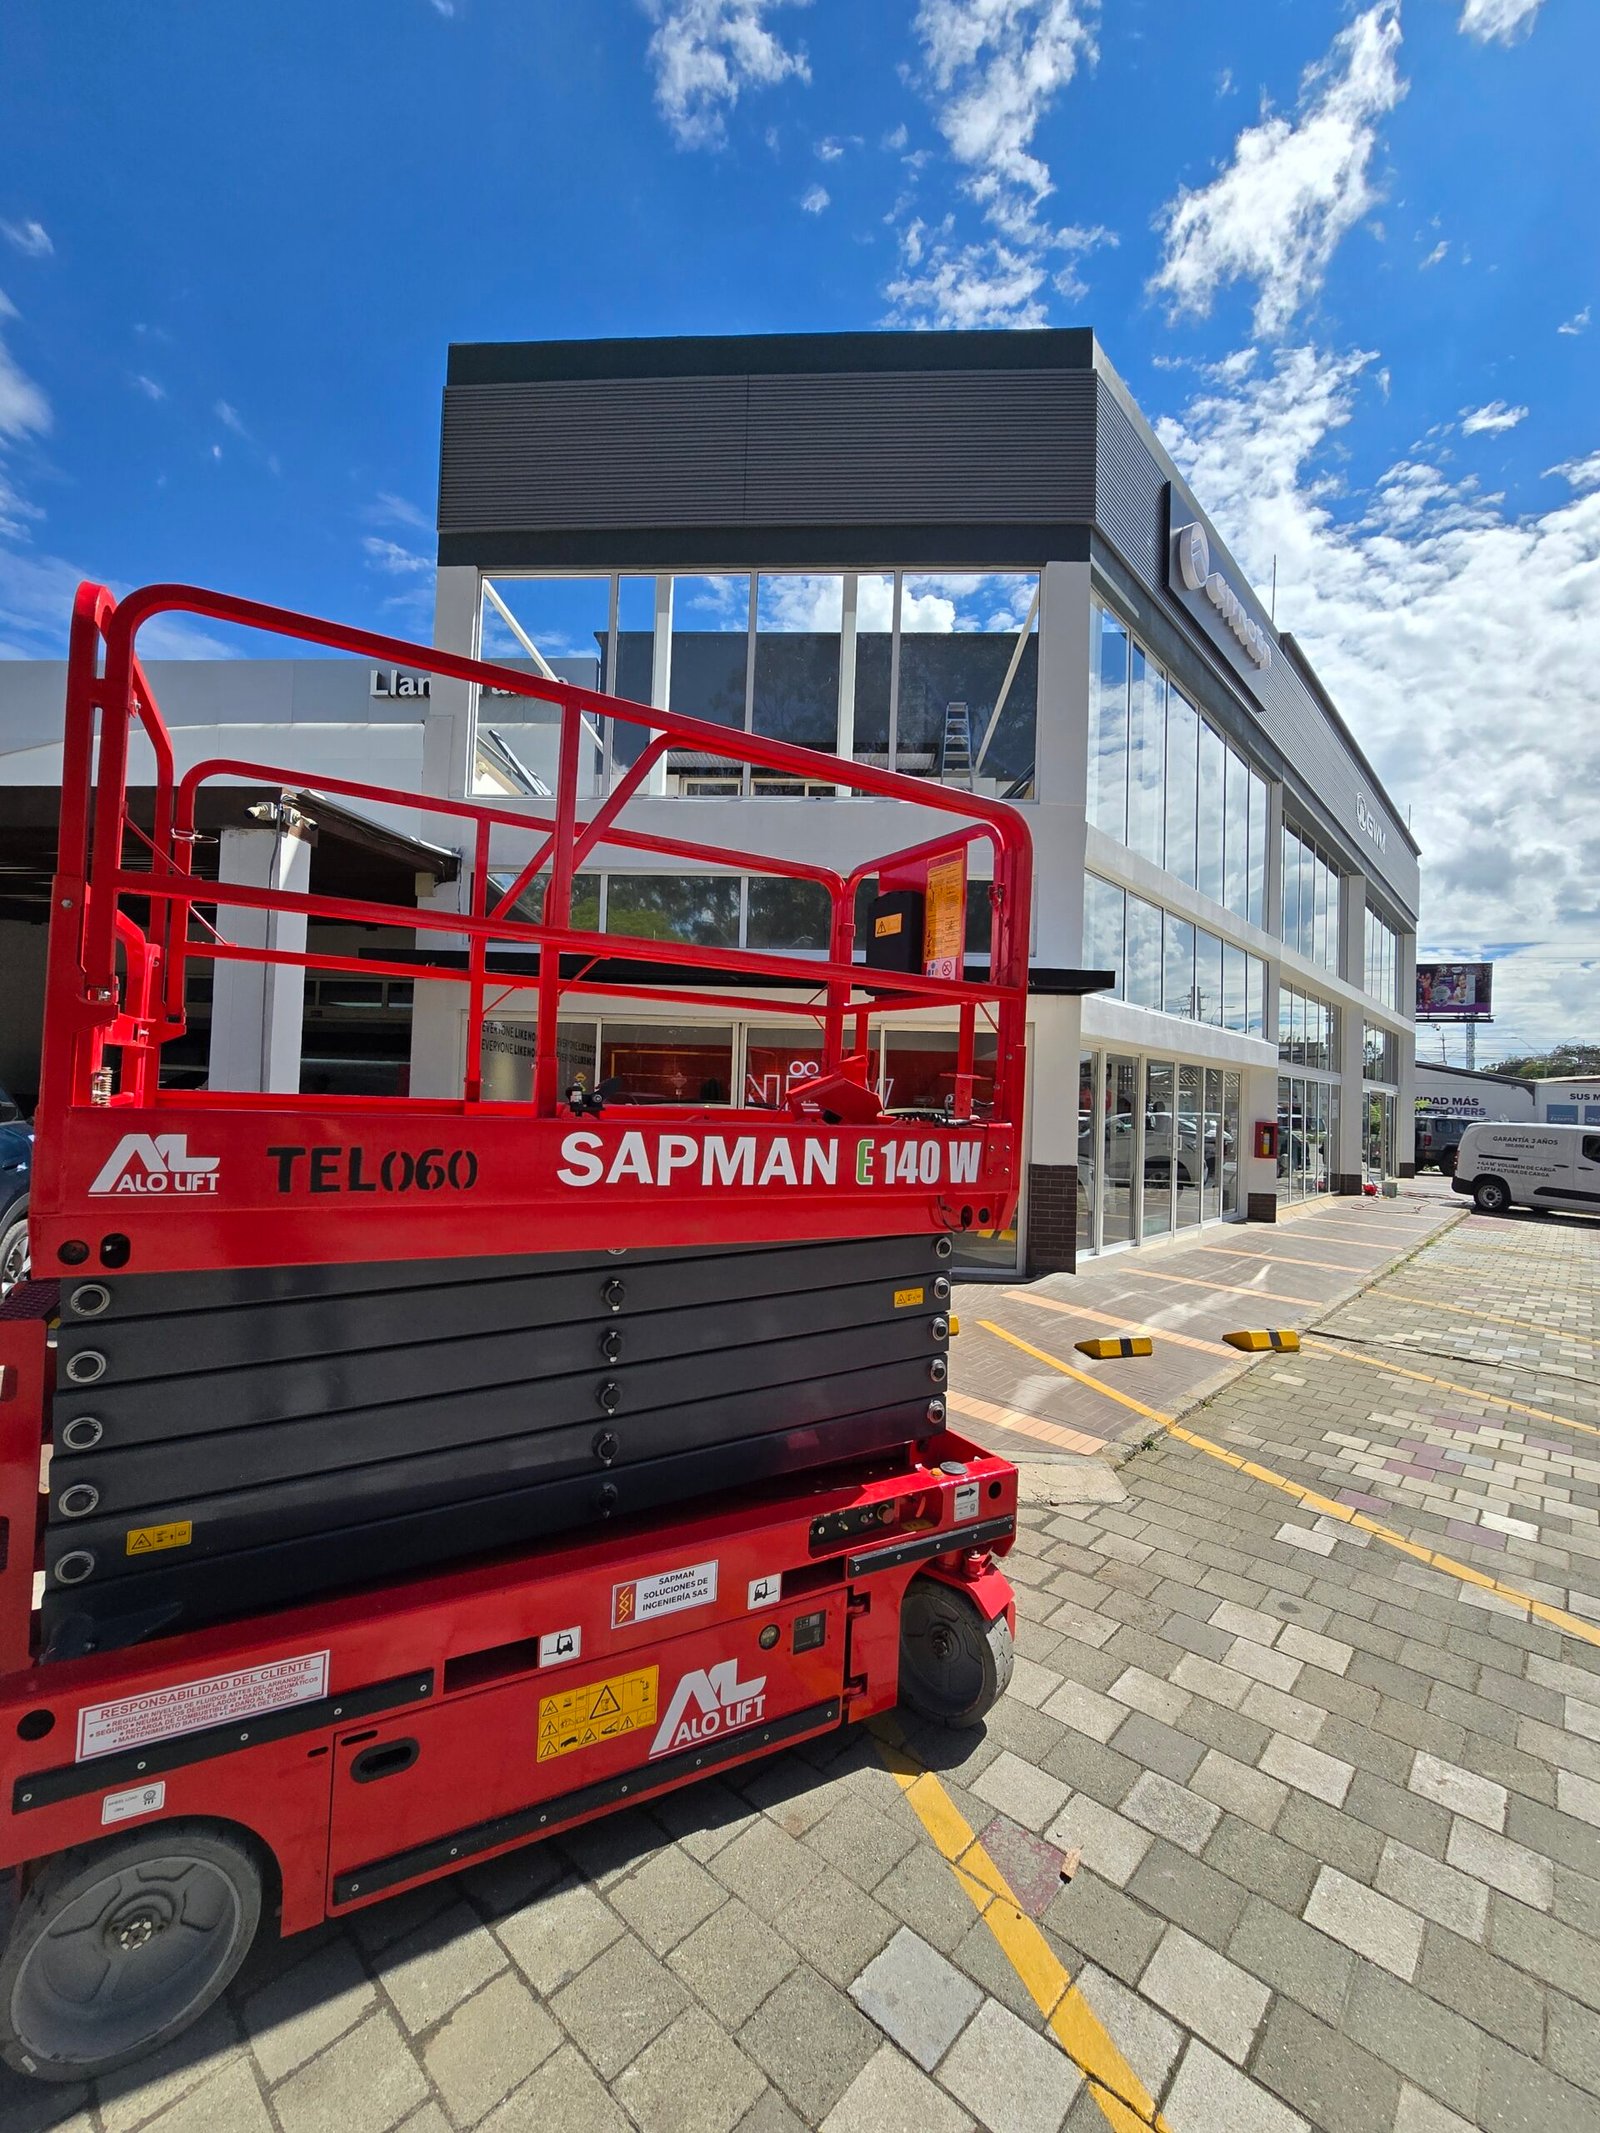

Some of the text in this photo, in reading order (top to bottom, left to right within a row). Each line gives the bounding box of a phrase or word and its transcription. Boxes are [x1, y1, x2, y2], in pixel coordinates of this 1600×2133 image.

[1452, 1095, 1479, 1106] MÁS
[116, 1173, 220, 1192] ALO LIFT
[557, 1131, 838, 1187] SAPMAN
[642, 1588, 708, 1611] INGENIERÍA SAS
[643, 1577, 708, 1600] SOLUCIONES DE
[659, 1570, 695, 1585] SAPMAN
[95, 1724, 129, 1737] SEGURO
[136, 1710, 185, 1726] NEUMÁTICOS
[187, 1697, 239, 1714] DESINFLADOS
[275, 1677, 318, 1692] NEUMÁTICOS
[101, 1661, 312, 1719] RESPONSABILIDAD DEL CLIENTE
[112, 1713, 149, 1727] REGULAR
[151, 1705, 182, 1717] NIVELES
[196, 1694, 227, 1706] FLUIDOS
[228, 1688, 251, 1697] ANTES
[253, 1685, 266, 1693] DEL
[268, 1674, 305, 1688] ARRANQUE
[125, 1721, 163, 1735] RECARGA
[177, 1704, 230, 1722] COMBUSTIBLE
[267, 1689, 293, 1699] EQUIPO
[118, 1723, 180, 1742] MANTENIMIENTO
[225, 1704, 256, 1715] LIMPIEZA
[272, 1692, 298, 1703] EQUIPO
[674, 1694, 766, 1746] ALO LIFT
